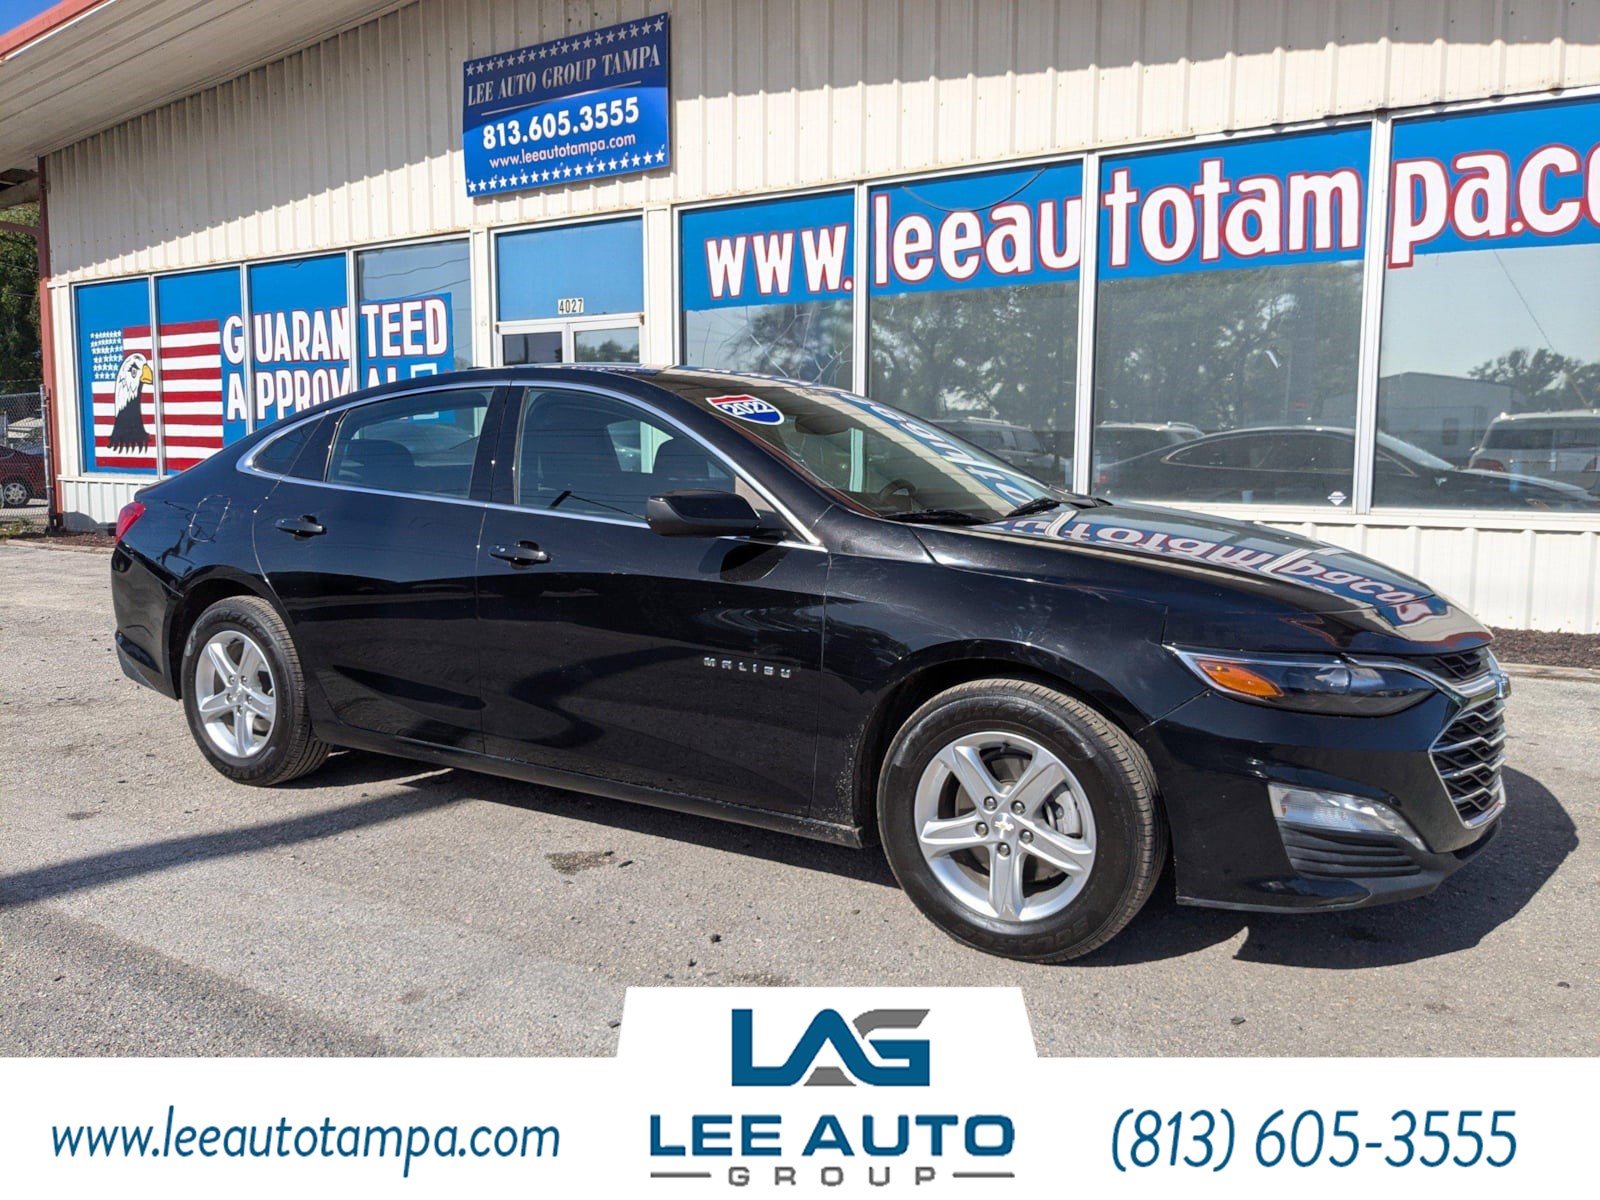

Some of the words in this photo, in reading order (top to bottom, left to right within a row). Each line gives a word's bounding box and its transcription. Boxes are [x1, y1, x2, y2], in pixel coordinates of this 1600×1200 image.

[468, 80, 494, 106] LEE
[498, 71, 537, 100] AUTO
[541, 57, 597, 90] GROUP
[602, 44, 661, 77] TAMPA
[482, 96, 640, 150] 813.605.3555
[489, 133, 637, 169] www.leeautotampa.com
[559, 299, 583, 314] 4027
[721, 401, 776, 416] 2022
[703, 656, 792, 679] MALIBU
